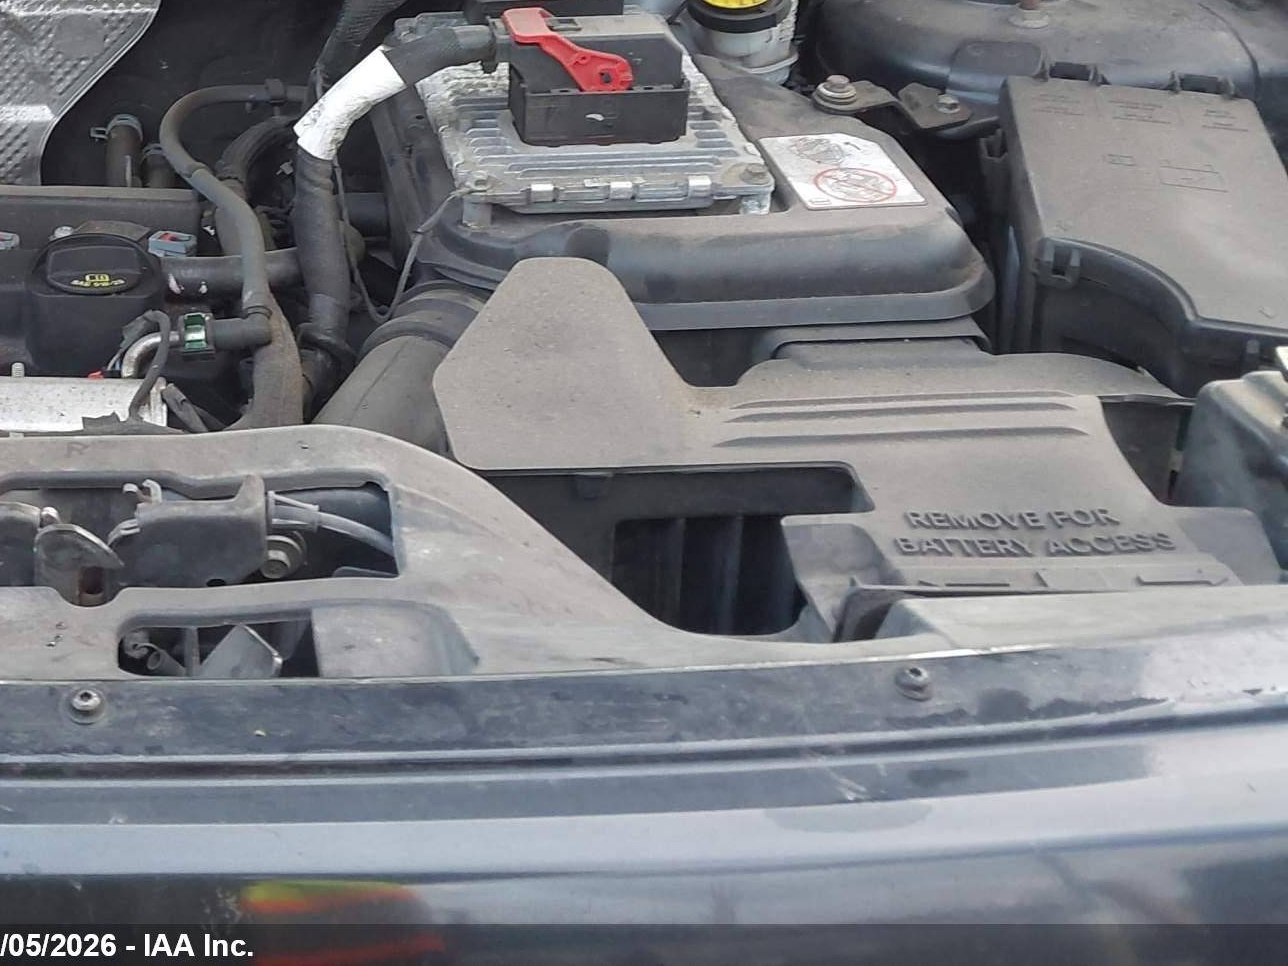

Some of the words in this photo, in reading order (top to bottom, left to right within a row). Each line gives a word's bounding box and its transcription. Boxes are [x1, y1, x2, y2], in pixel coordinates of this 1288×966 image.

[903, 510, 1045, 530] REMOVE
[1048, 508, 1121, 529] FOR
[893, 537, 1035, 557] BATTERY
[1047, 533, 1177, 556] ACCESS
